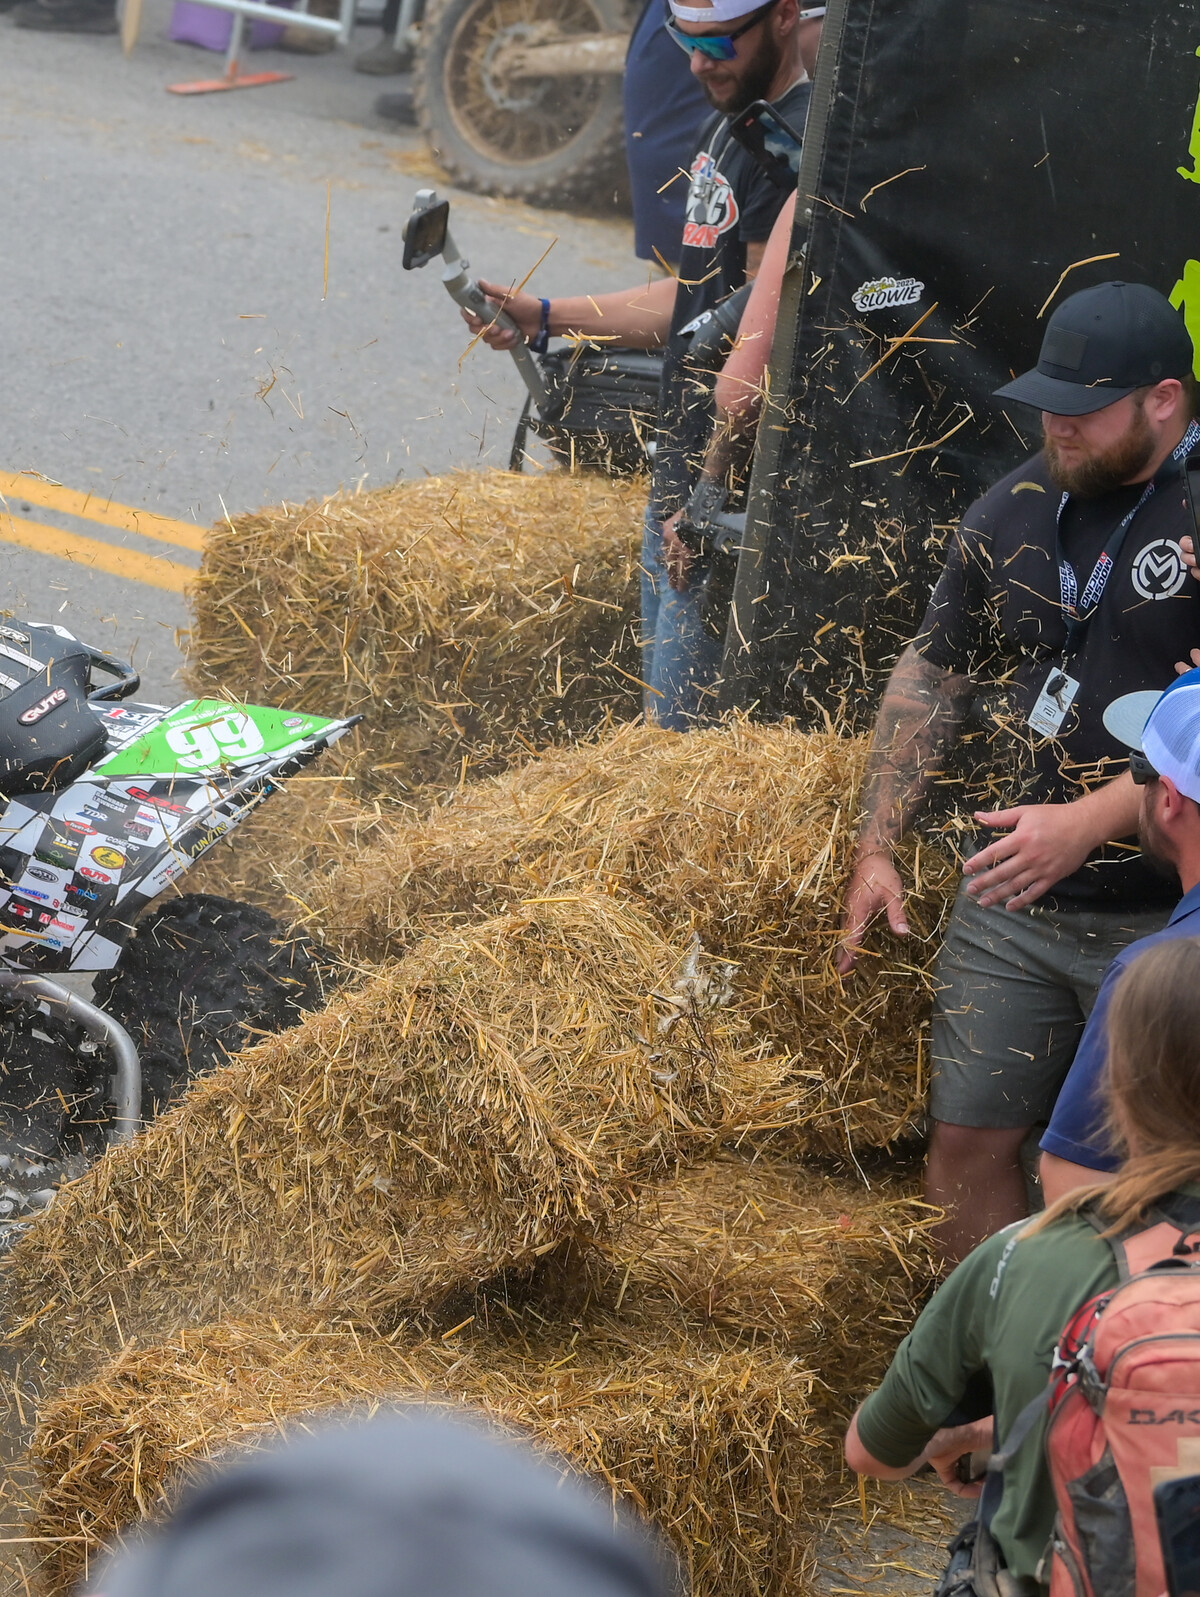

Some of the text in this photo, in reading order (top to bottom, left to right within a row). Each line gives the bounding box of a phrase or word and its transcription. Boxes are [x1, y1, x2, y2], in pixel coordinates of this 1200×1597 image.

[858, 284, 921, 309] SLOWIE
[896, 279, 915, 288] 2023
[1080, 559, 1103, 609] RACING
[1094, 556, 1113, 604] MOOSE
[20, 688, 67, 722] GUTS
[165, 712, 265, 768] 99
[126, 786, 194, 813] GBC
